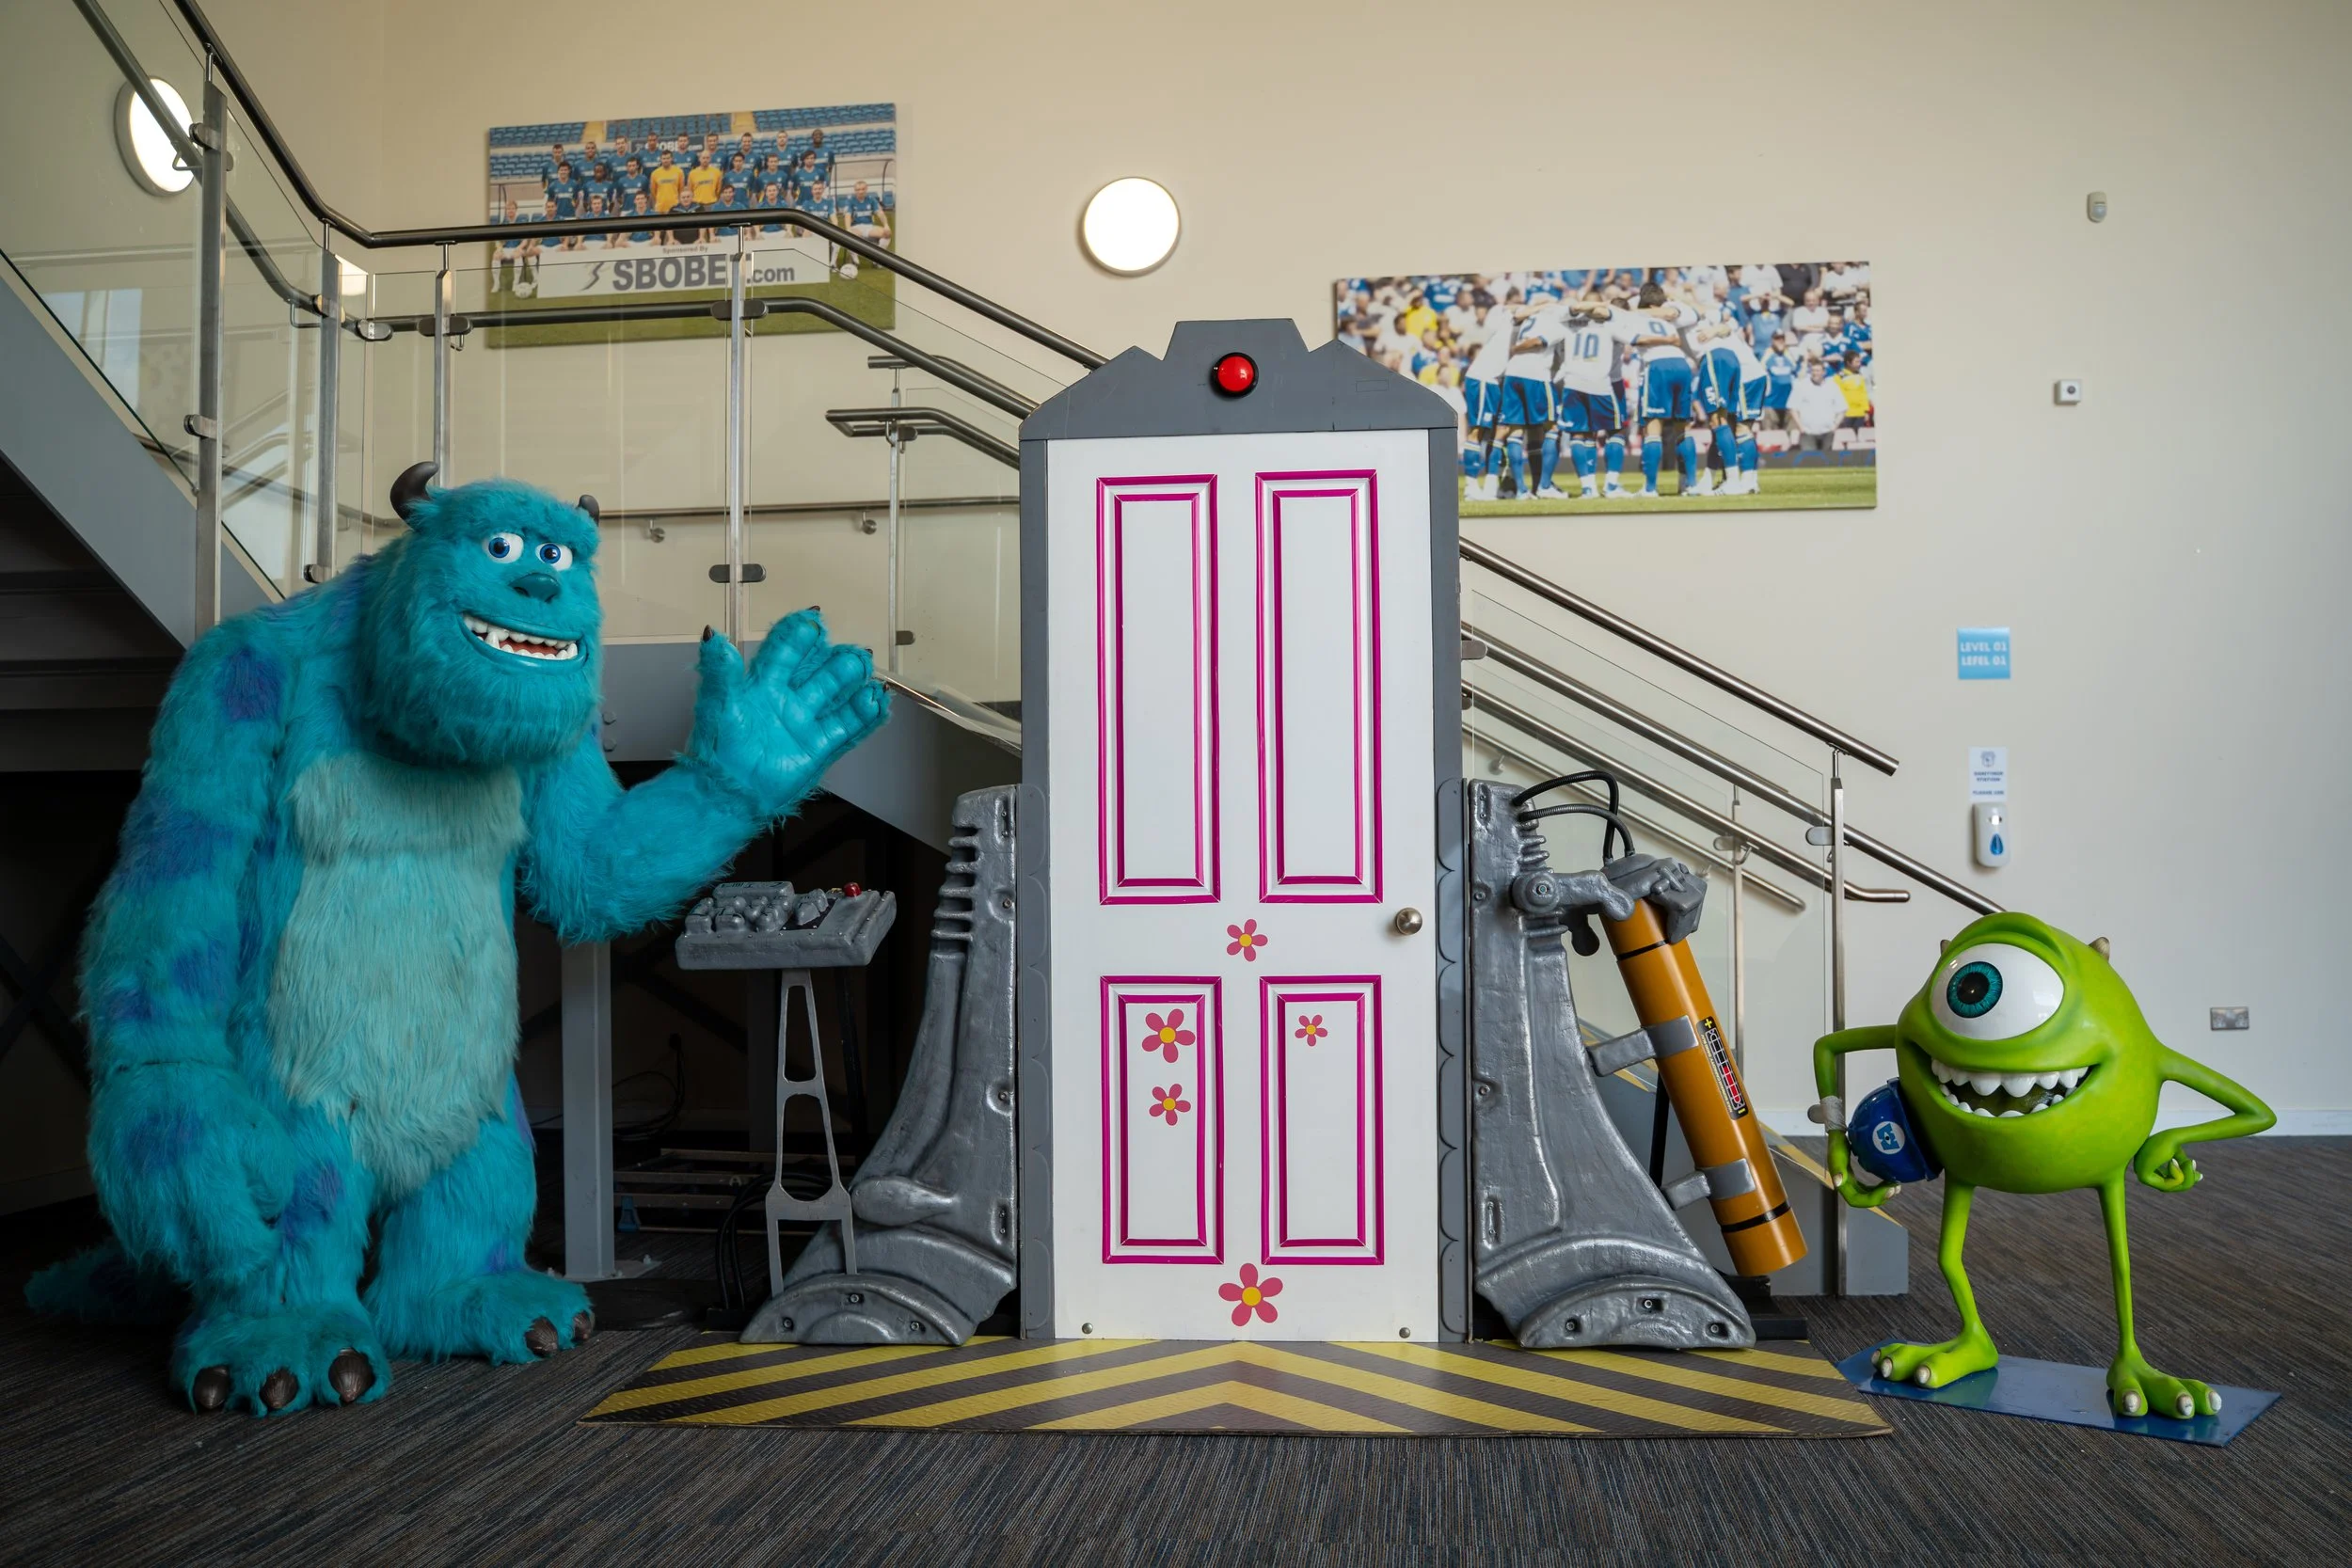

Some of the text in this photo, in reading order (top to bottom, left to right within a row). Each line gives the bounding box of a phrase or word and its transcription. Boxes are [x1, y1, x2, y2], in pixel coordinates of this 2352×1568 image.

[1574, 333, 1598, 358] 10
[1961, 641, 2007, 652] LEVEL 01
[1993, 656, 2007, 666] 01
